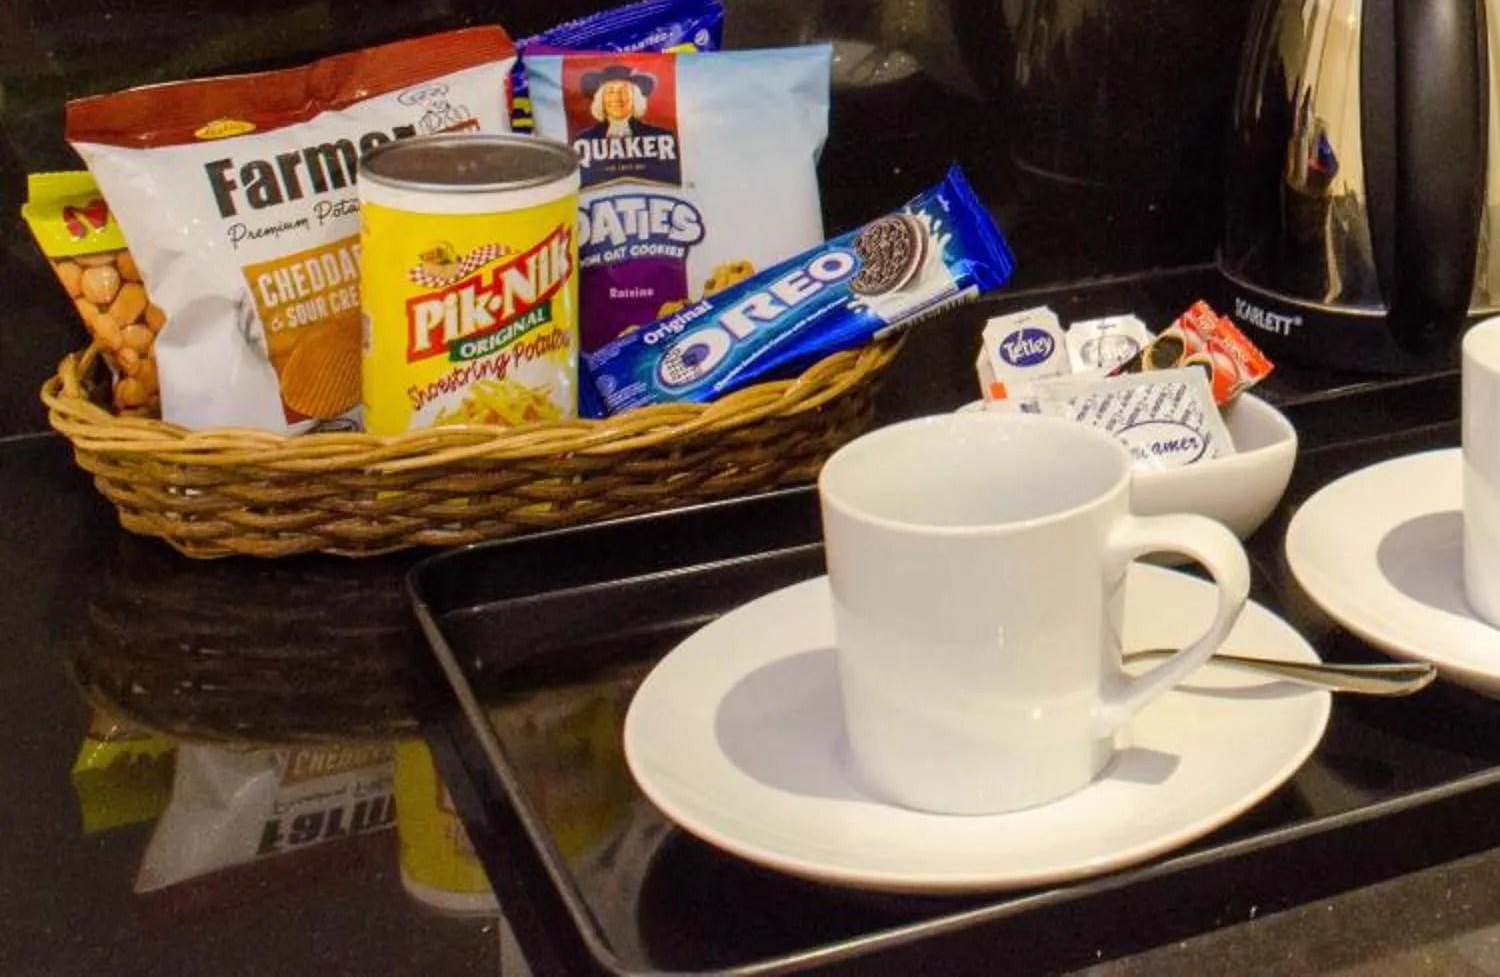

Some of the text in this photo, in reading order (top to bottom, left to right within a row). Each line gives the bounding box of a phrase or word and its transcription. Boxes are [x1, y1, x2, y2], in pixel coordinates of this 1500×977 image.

[573, 134, 677, 169] QUAKER
[204, 124, 416, 219] Farme
[227, 217, 311, 250] Premium
[629, 242, 686, 259] COOKIES
[287, 297, 330, 329] SOUR
[643, 299, 714, 345] Original
[660, 251, 855, 391] OREO
[459, 307, 547, 359] ORIGINAL
[1003, 331, 1052, 364] Tetley
